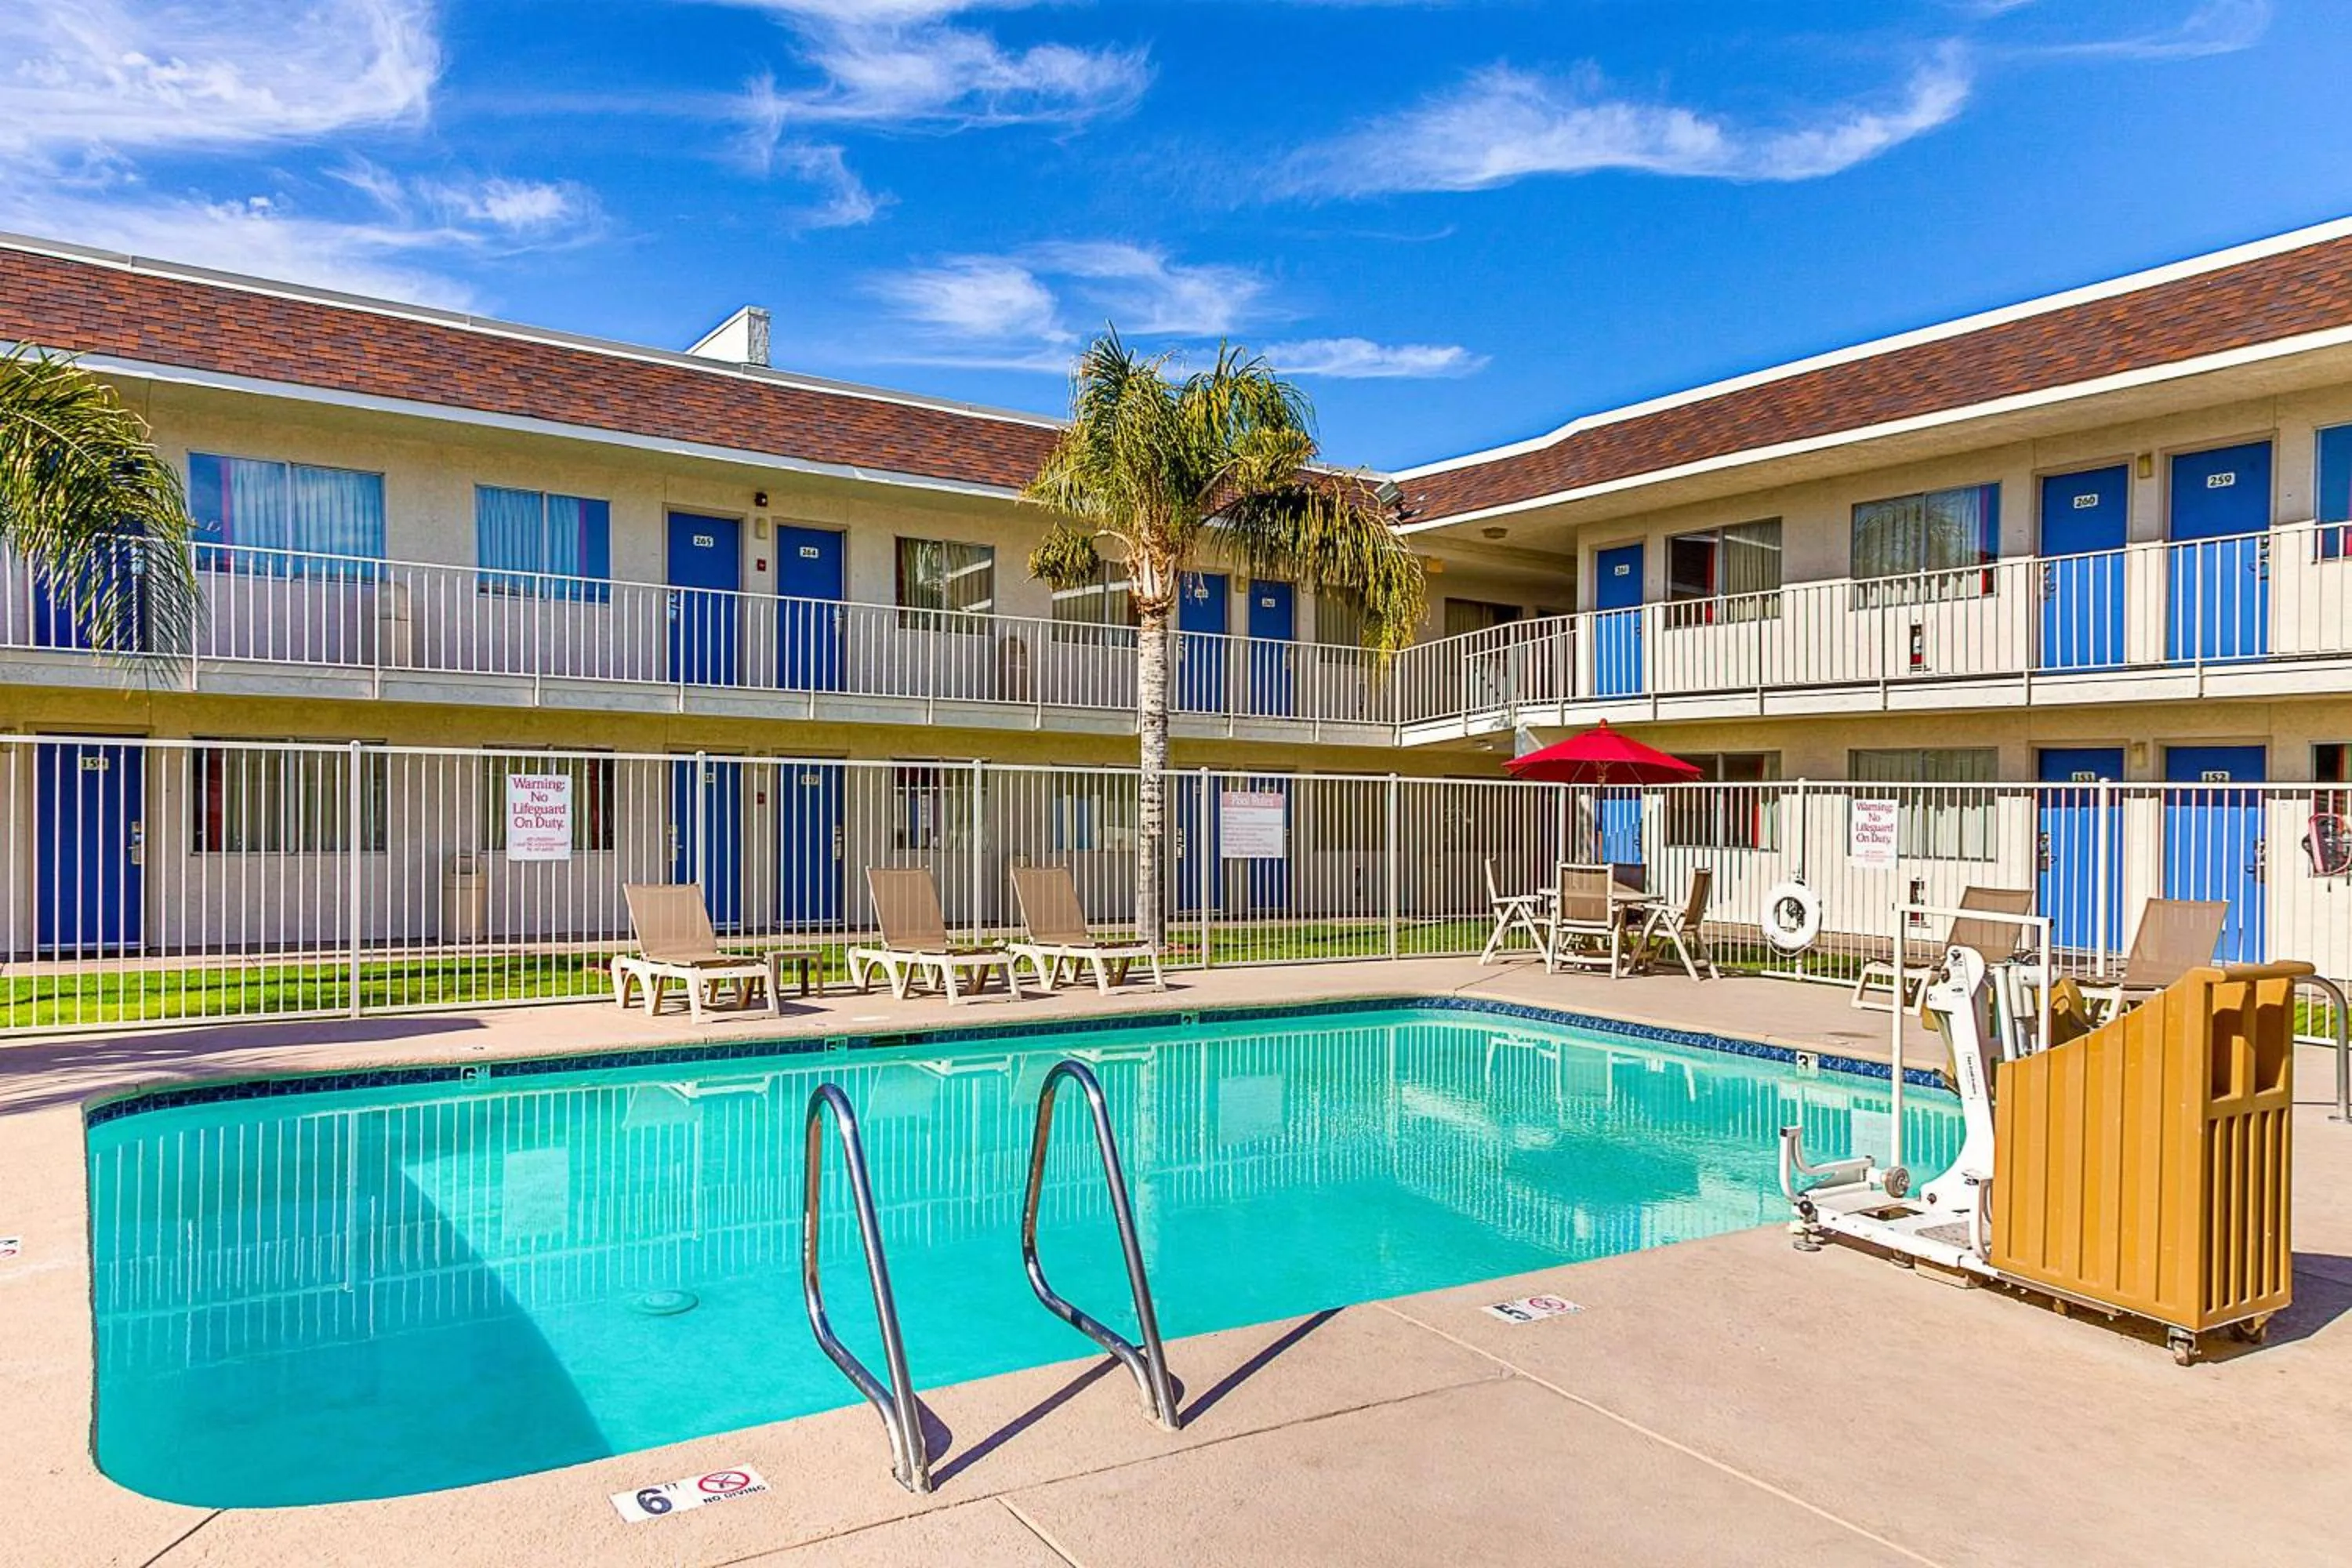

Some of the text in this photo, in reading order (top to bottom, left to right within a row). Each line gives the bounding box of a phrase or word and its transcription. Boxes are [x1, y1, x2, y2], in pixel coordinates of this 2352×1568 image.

[2210, 474, 2232, 486] 259
[2077, 496, 2095, 507] 260
[695, 537, 711, 546] 265
[531, 791, 548, 802] No
[513, 803, 566, 816] Lifeguard
[514, 816, 532, 828] On
[1868, 812, 1881, 822] No
[1856, 822, 1893, 834] Lifeguard
[1856, 833, 1869, 843] On
[702, 1484, 766, 1504] NO DIVING
[636, 1487, 673, 1515] 6
